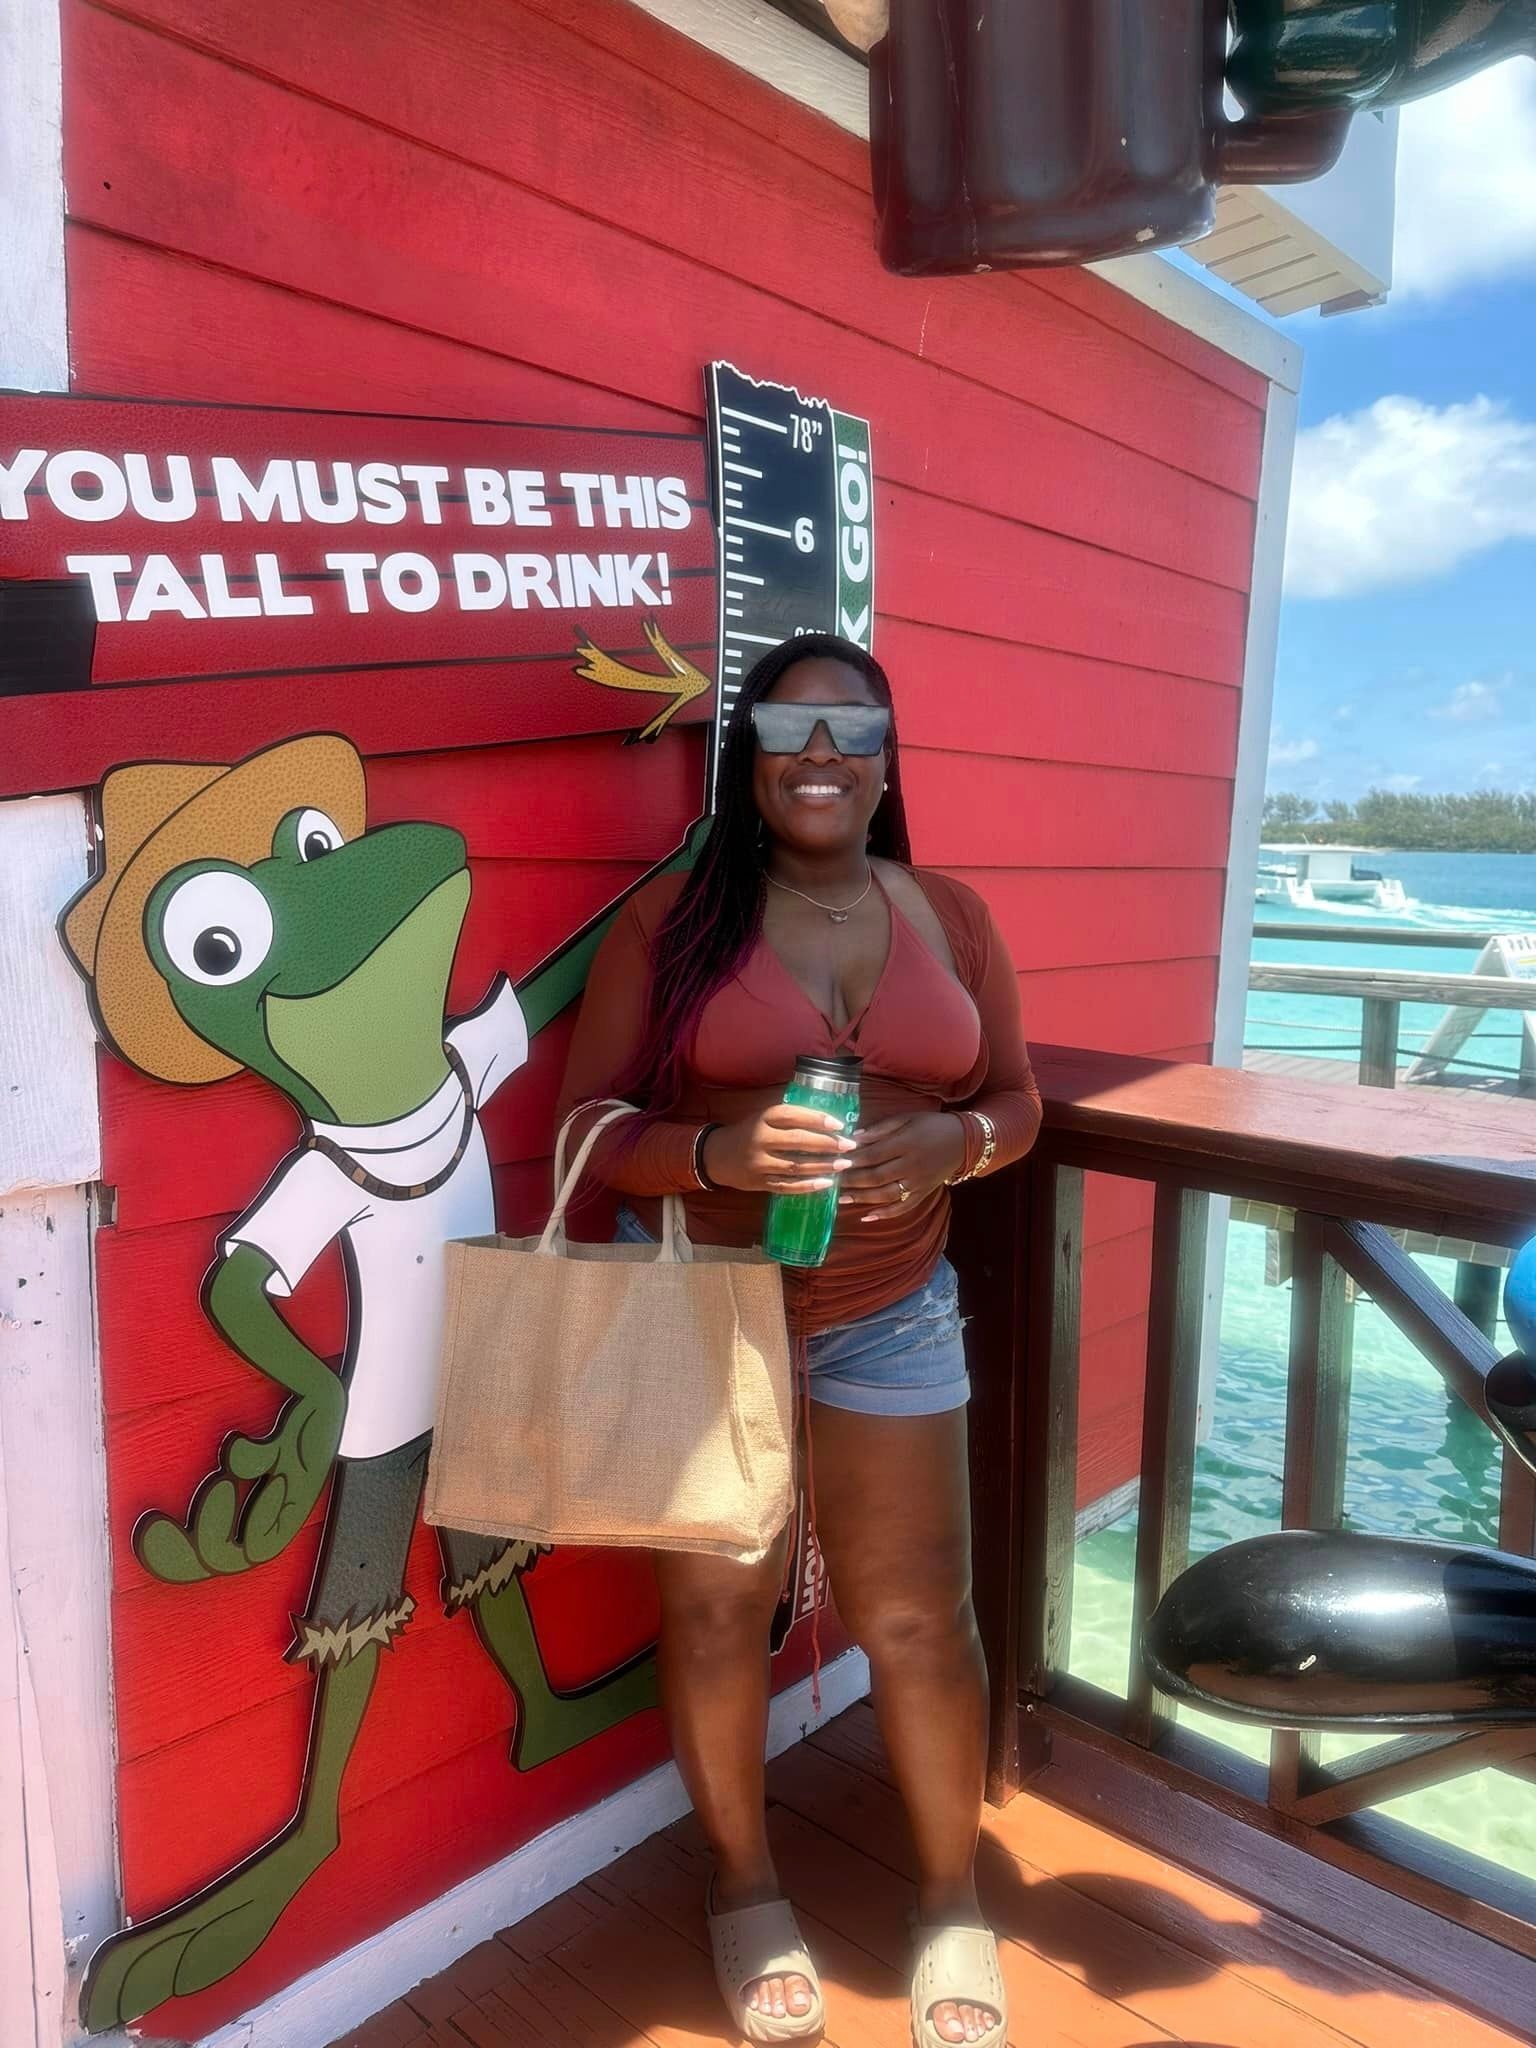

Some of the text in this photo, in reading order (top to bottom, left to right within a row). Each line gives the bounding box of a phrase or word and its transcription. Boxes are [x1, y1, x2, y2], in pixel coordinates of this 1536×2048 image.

[0, 449, 692, 531] YOU MUST BE THIS
[838, 444, 870, 583] GO!
[794, 516, 816, 554] 6
[65, 551, 674, 623] TALL TO DRINK!
